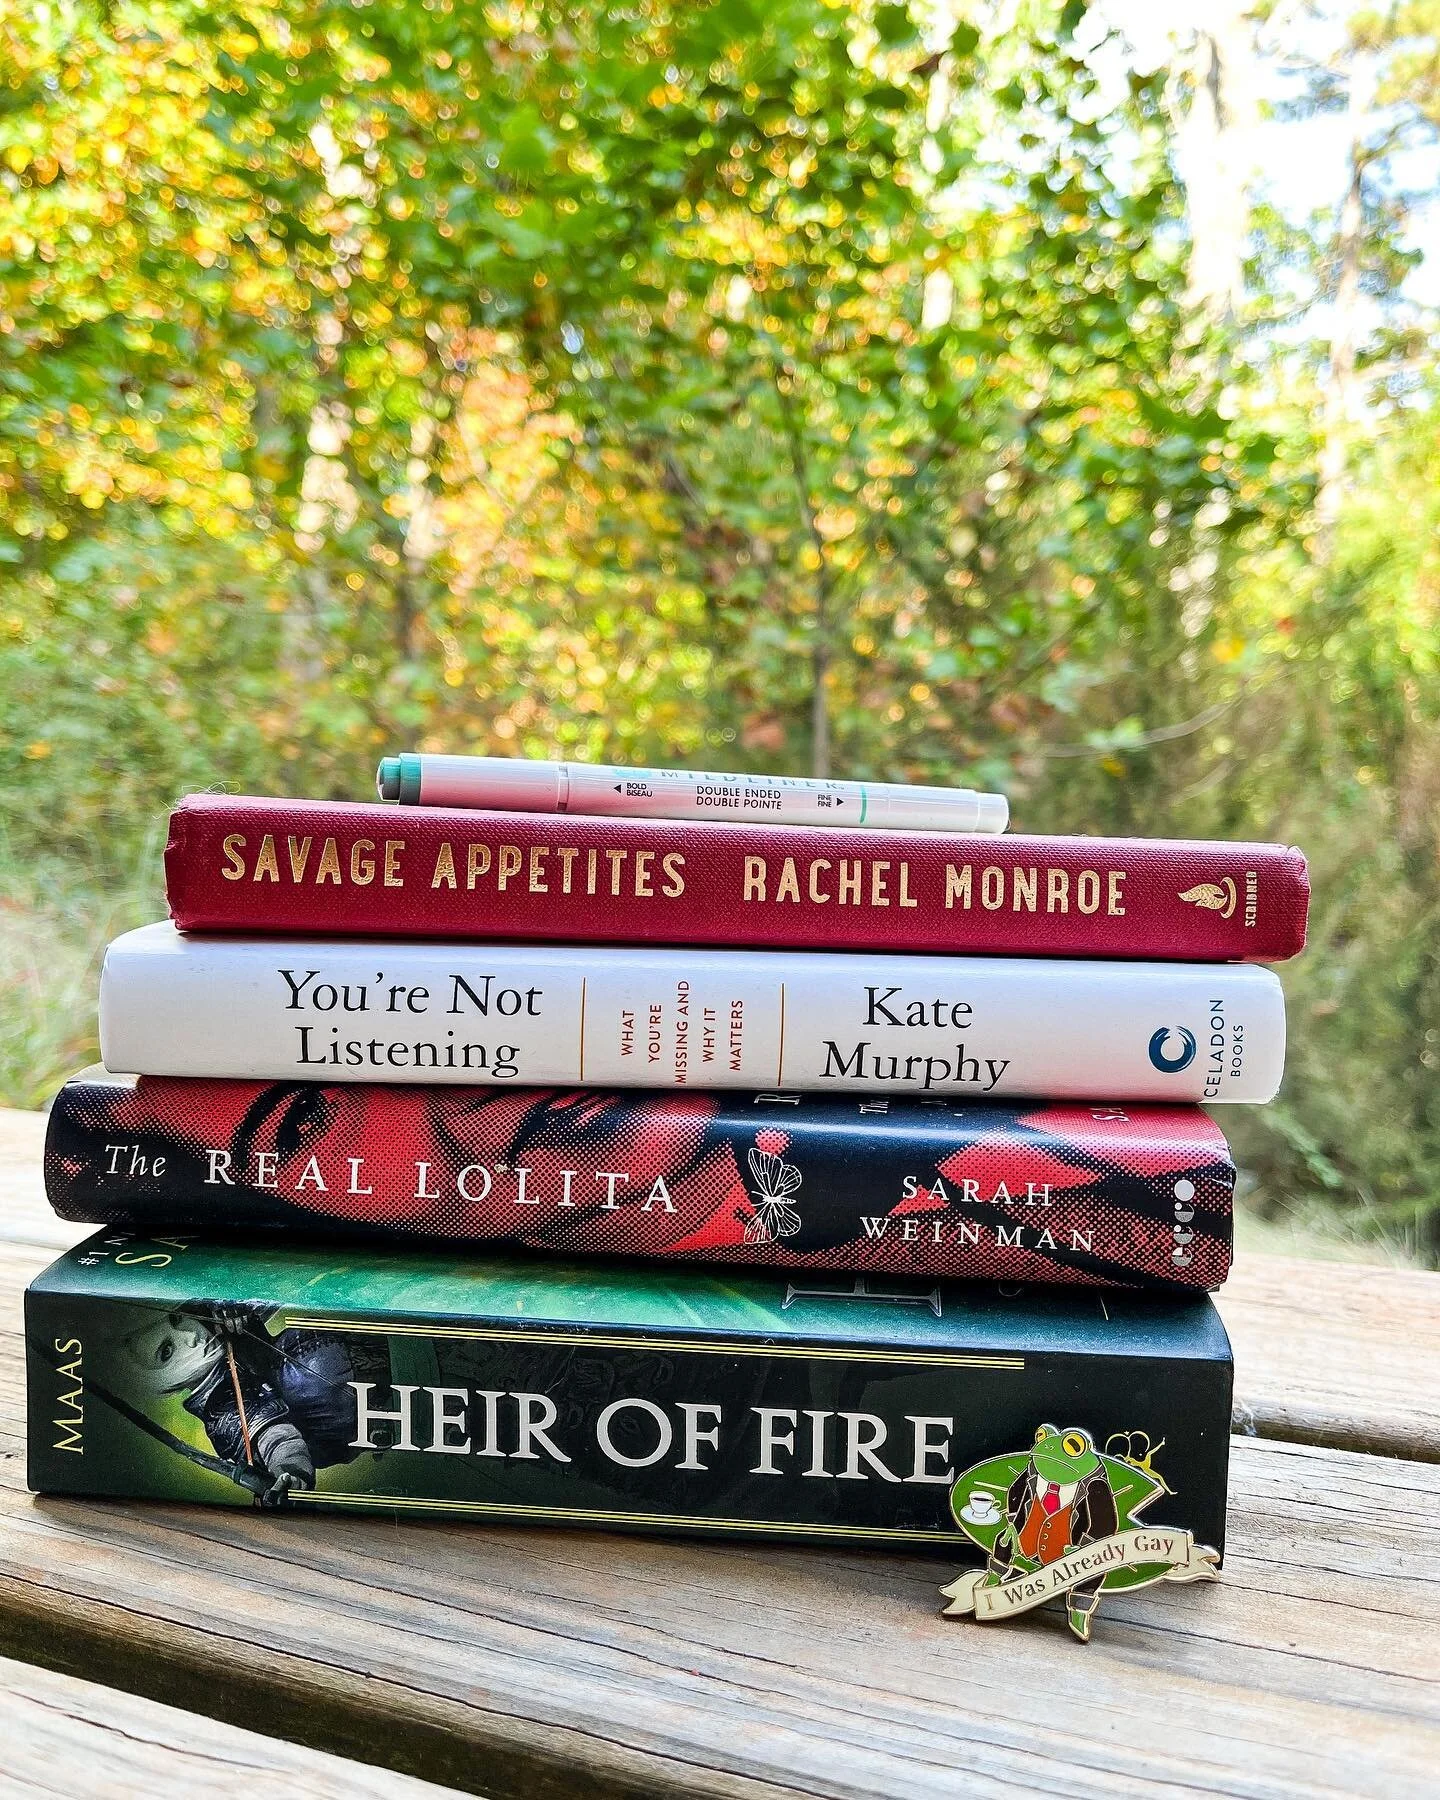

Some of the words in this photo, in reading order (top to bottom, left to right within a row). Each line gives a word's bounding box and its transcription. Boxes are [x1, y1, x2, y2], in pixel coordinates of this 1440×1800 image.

[626, 782, 647, 790] BOLD
[626, 790, 653, 798] BISEAU
[696, 785, 740, 797] DOUBLE
[745, 789, 781, 799] ENDED
[696, 797, 740, 808] DOUBLE
[743, 799, 782, 810] POINTE
[221, 834, 405, 887] SAVAGE
[430, 842, 686, 898] APPETITES
[743, 855, 917, 908] RACHEL
[945, 864, 1127, 916] MONROE
[1244, 871, 1258, 927] SCRIBNER
[278, 969, 430, 1014] You're
[446, 974, 543, 1017] Not
[677, 981, 690, 1016] AND
[704, 1008, 716, 1021] IT
[862, 986, 973, 1029] Kate
[295, 1026, 520, 1078] Listening
[621, 1010, 634, 1056] WHAT
[648, 1004, 662, 1063] YOU'RE
[675, 1021, 688, 1084] MISSING
[702, 1026, 715, 1063] WHY
[729, 1000, 743, 1071] MATTERS
[1203, 999, 1225, 1098] CELADON
[1230, 1025, 1244, 1077] BOOKS
[819, 1040, 1011, 1091] Murphy
[103, 1144, 167, 1177] The
[203, 1148, 374, 1195] REAL
[414, 1161, 677, 1214] LOLITA
[902, 1175, 1054, 1207] SARAH
[860, 1216, 1095, 1253] WEINMAN
[53, 1338, 84, 1455] MAAS
[346, 1381, 572, 1463] HEIR
[596, 1398, 722, 1471] OF
[749, 1407, 955, 1484] FIRE
[984, 1593, 994, 1610] I
[1002, 1578, 1046, 1604] Was
[1052, 1544, 1126, 1589] Already
[1133, 1535, 1174, 1554] Gay
